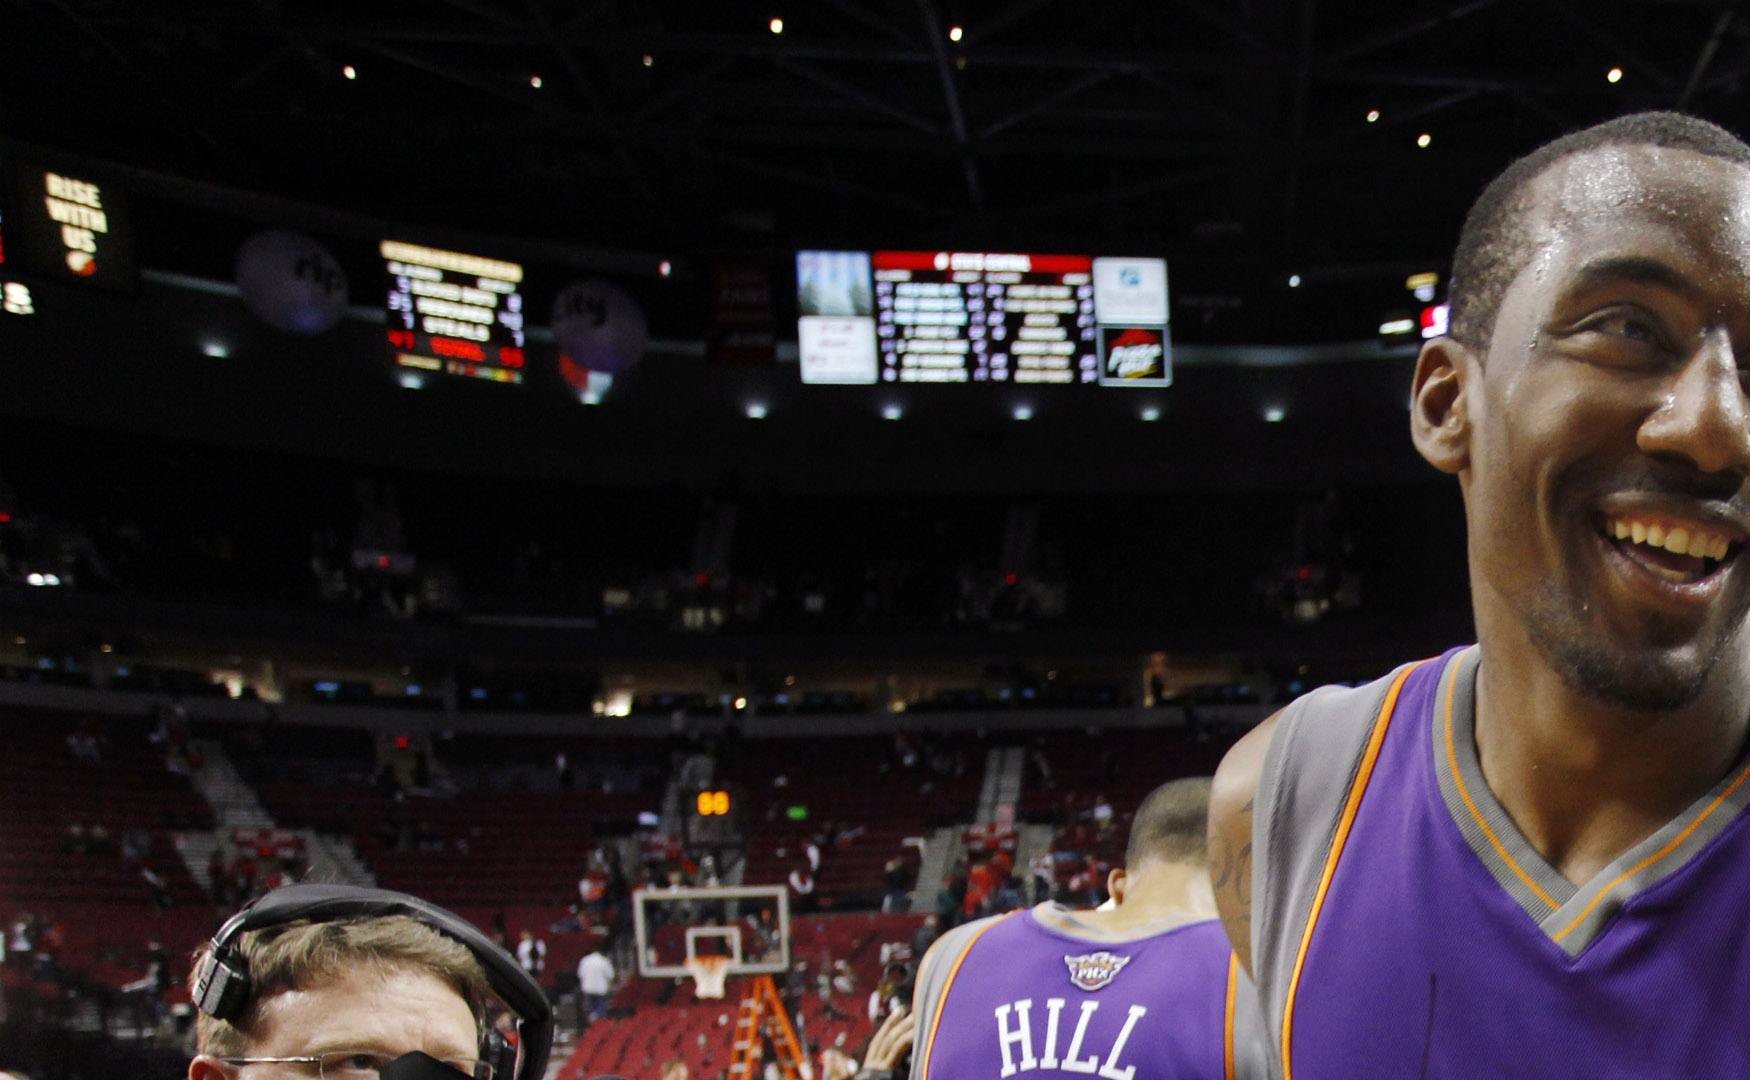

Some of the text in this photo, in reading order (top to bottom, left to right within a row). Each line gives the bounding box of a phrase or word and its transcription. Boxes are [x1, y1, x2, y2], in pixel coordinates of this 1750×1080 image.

[45, 172, 102, 209] RISE
[45, 196, 108, 233] WITH
[61, 224, 97, 253] US
